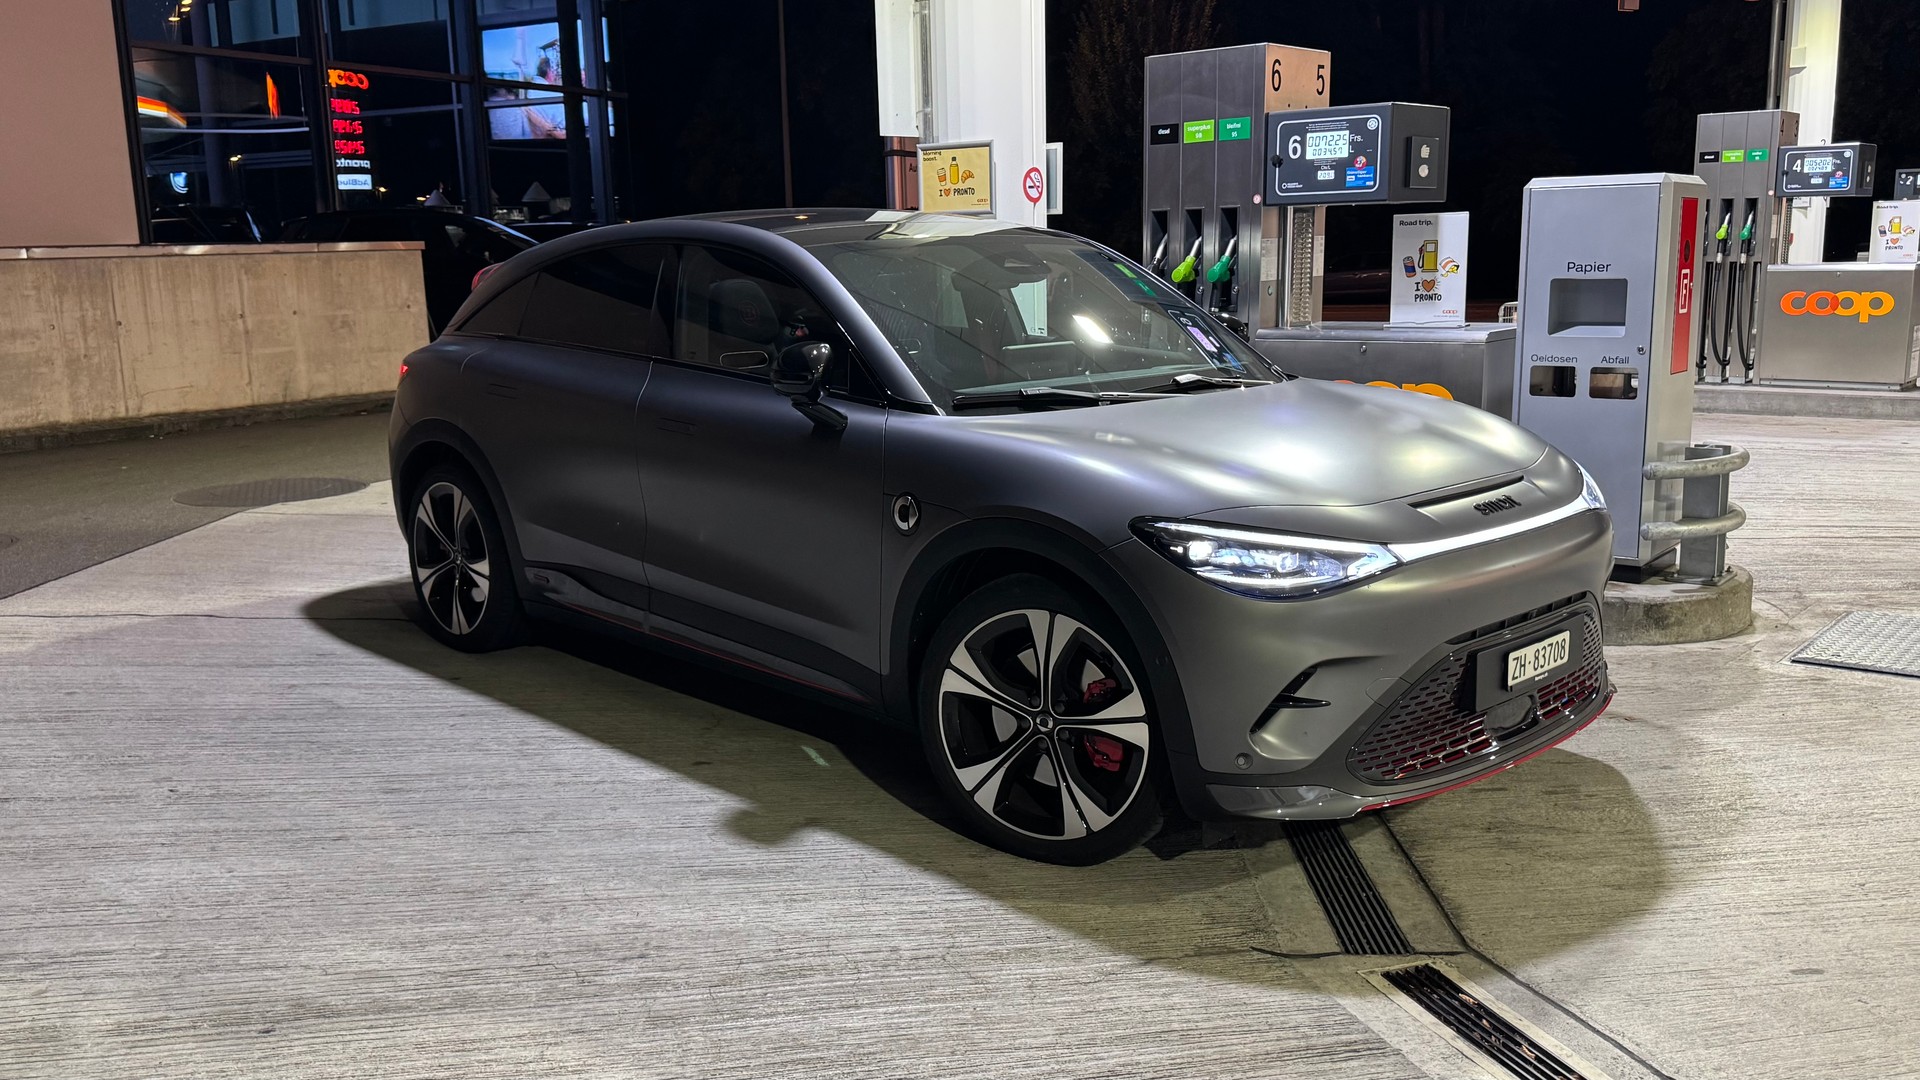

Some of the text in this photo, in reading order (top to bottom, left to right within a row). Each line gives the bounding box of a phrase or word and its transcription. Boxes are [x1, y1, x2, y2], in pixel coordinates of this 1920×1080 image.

[1271, 58, 1282, 92] 6
[1316, 64, 1325, 96] 5
[1350, 133, 1364, 142] Frs.
[1288, 135, 1302, 159] 6
[1350, 145, 1354, 153] L
[1792, 159, 1801, 173] 4
[1906, 175, 1913, 185] 2
[939, 187, 975, 197] I PRONTO
[1419, 219, 1433, 227] trip.
[1567, 261, 1612, 275] Papier
[1414, 281, 1420, 292] I
[1414, 293, 1442, 303] PRONTO
[1780, 290, 1895, 323] coop
[1530, 354, 1578, 364] Oeldosen
[1600, 355, 1630, 365] Abfall
